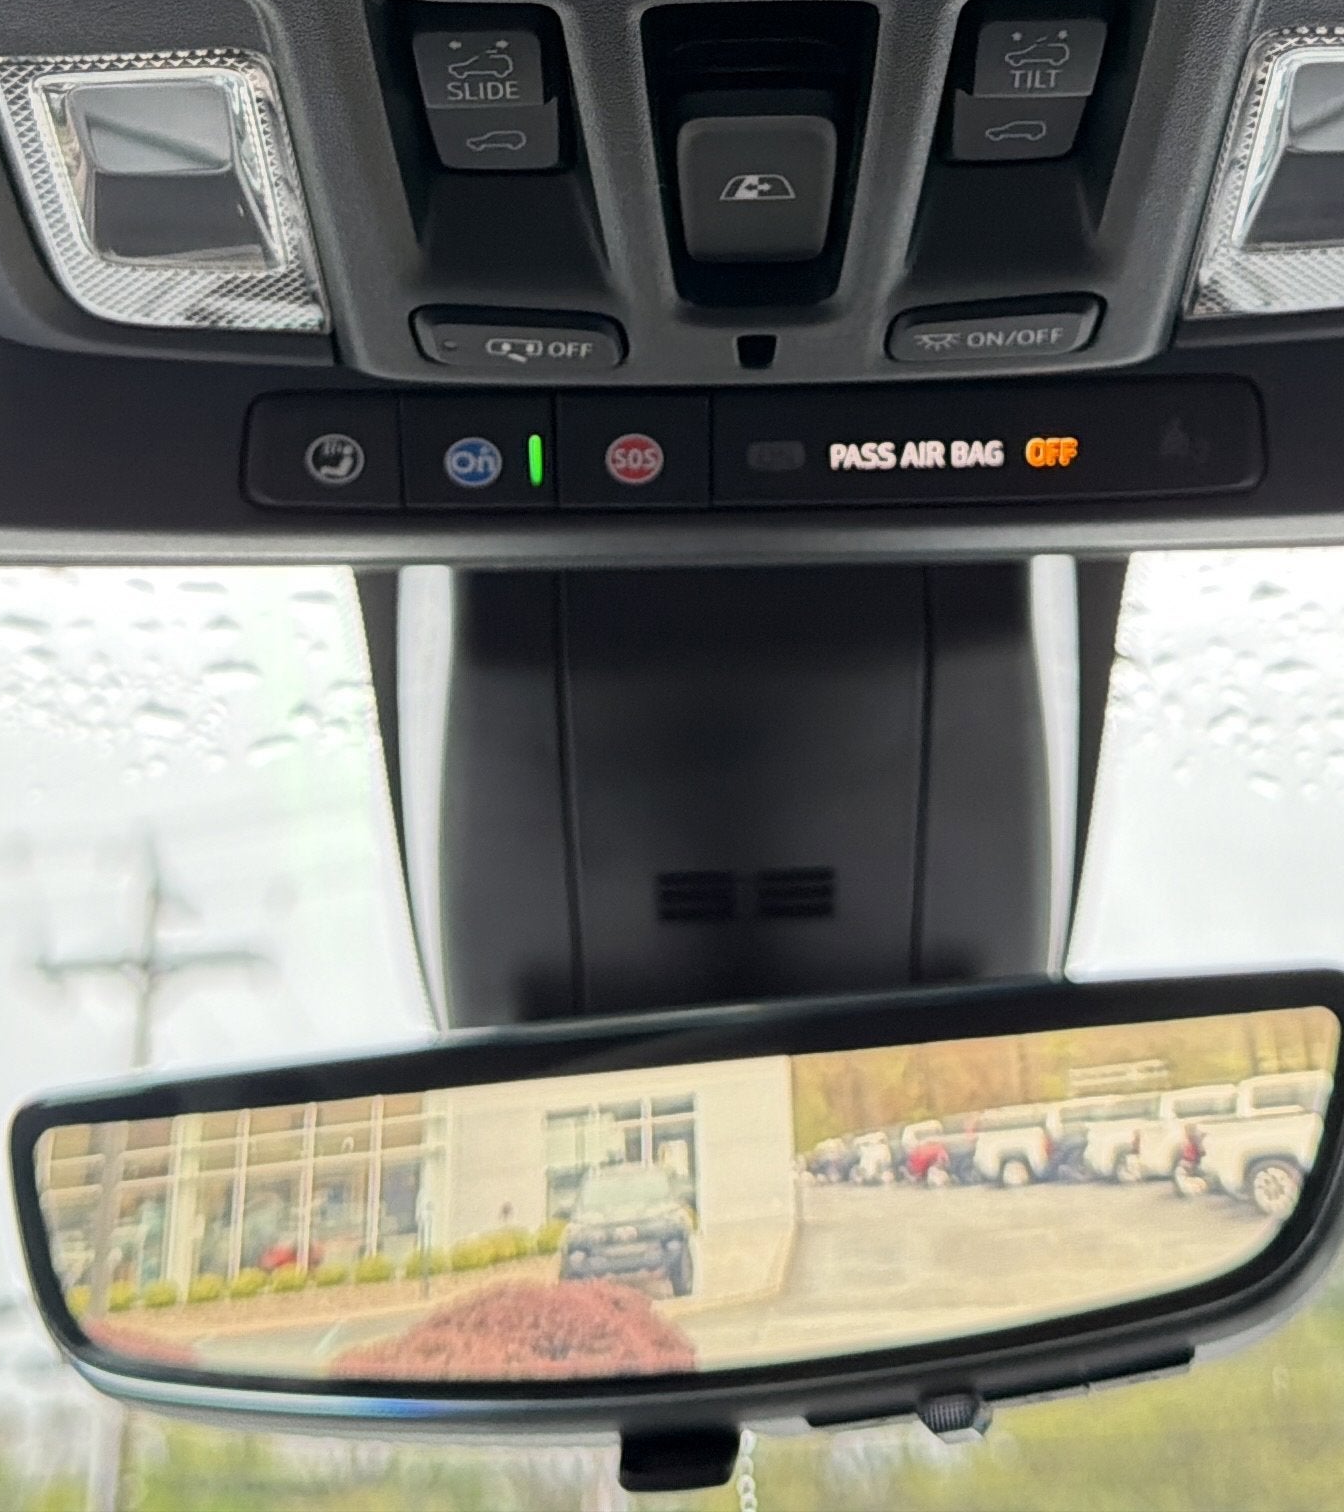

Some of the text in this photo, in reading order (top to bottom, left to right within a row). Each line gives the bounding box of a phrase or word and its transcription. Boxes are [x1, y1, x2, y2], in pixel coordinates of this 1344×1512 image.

[1010, 69, 1062, 89] TILT
[446, 81, 520, 100] SLIDE
[966, 327, 1063, 347] ON/OFF
[548, 342, 593, 358] OFF
[613, 448, 657, 469] SOS
[829, 438, 1078, 469] PASS AIR BAG OFF
